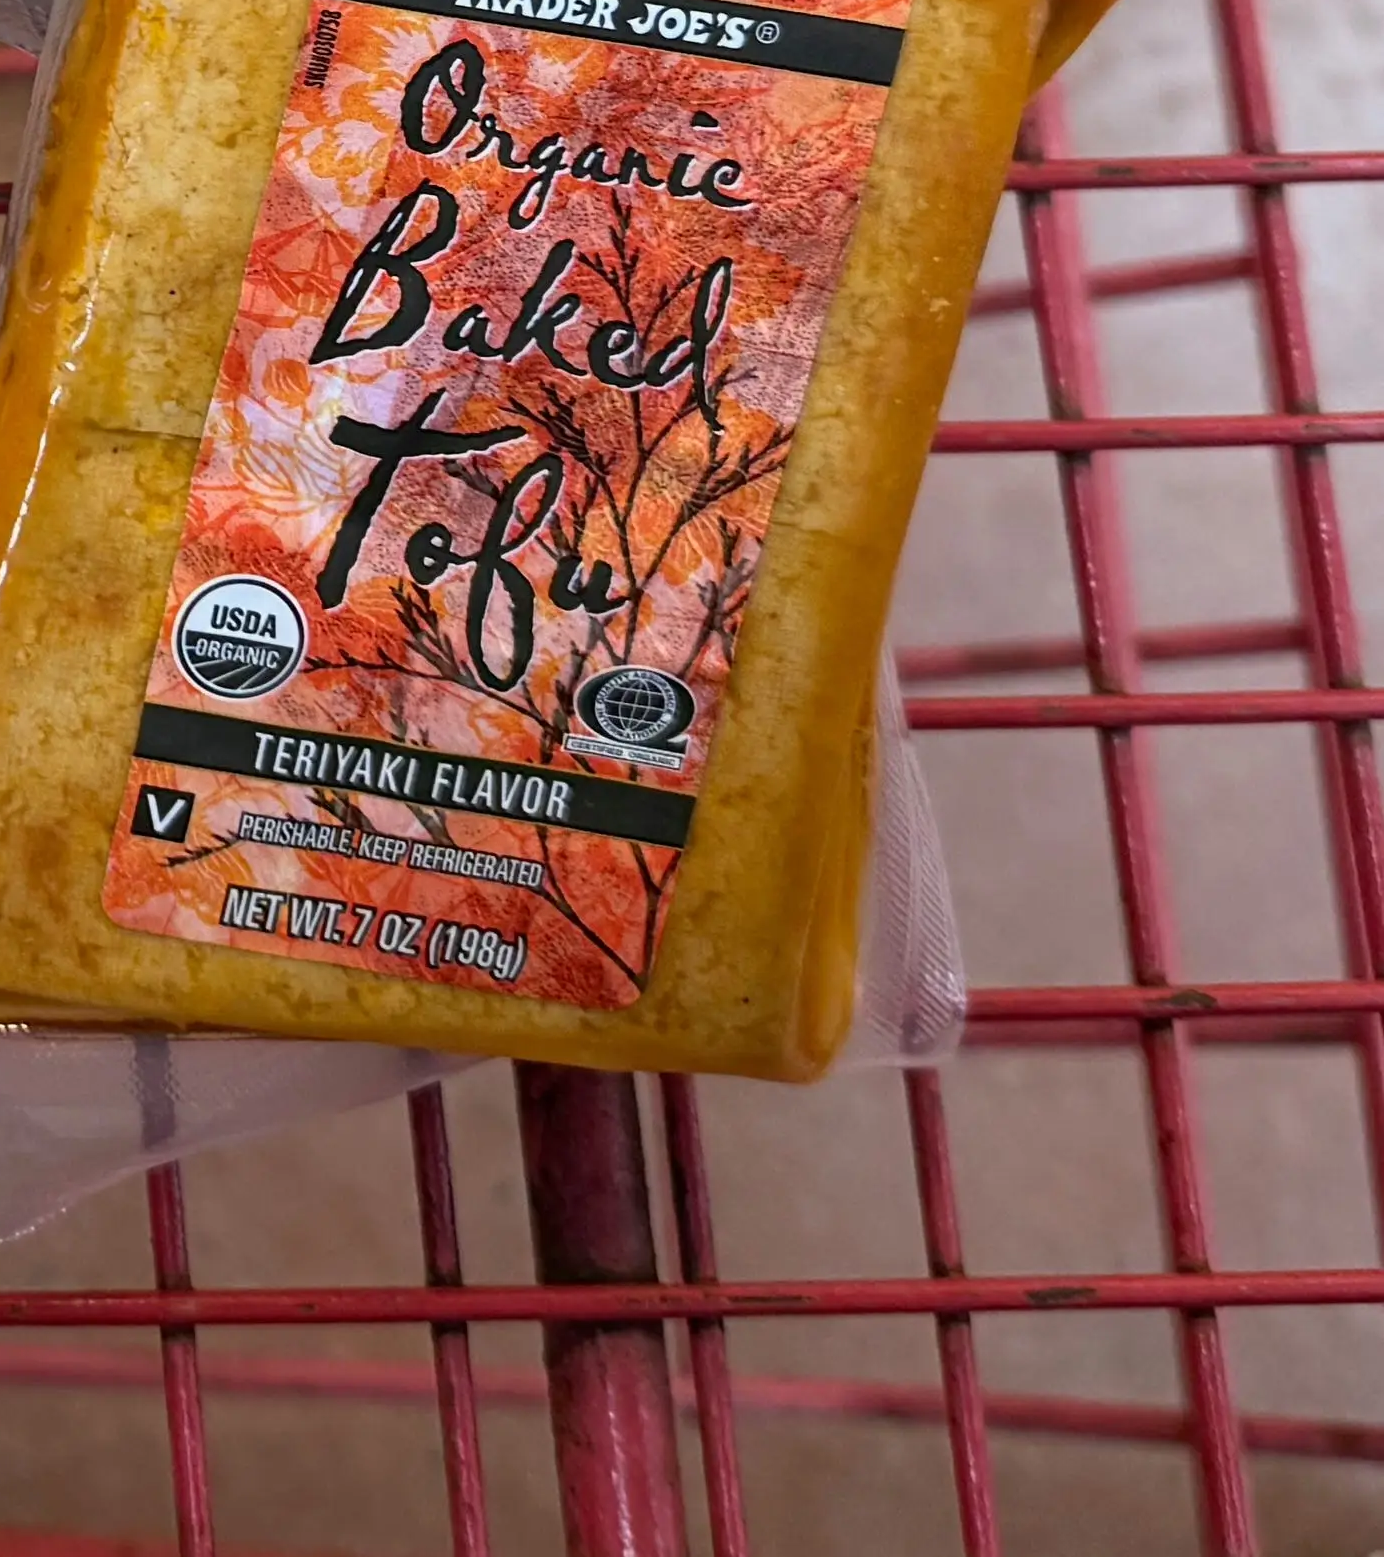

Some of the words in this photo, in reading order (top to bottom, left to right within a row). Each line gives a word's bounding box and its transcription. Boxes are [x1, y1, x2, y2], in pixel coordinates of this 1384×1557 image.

[400, 38, 760, 233] Organic
[308, 178, 735, 437] Baked
[315, 388, 632, 693] Tofu
[191, 636, 283, 670] ORGANIC
[209, 604, 279, 640] USDA
[254, 730, 417, 797] TERIYAKI
[431, 761, 573, 822] FLAVOR
[239, 814, 355, 856] PERISHABLE,
[357, 834, 408, 864] KEEP
[409, 846, 546, 887] REFRIGERATED
[221, 886, 285, 932] NET
[287, 896, 342, 942] WT.
[350, 906, 370, 940] 7
[378, 916, 423, 952] OZ
[429, 924, 527, 983] (198g)
